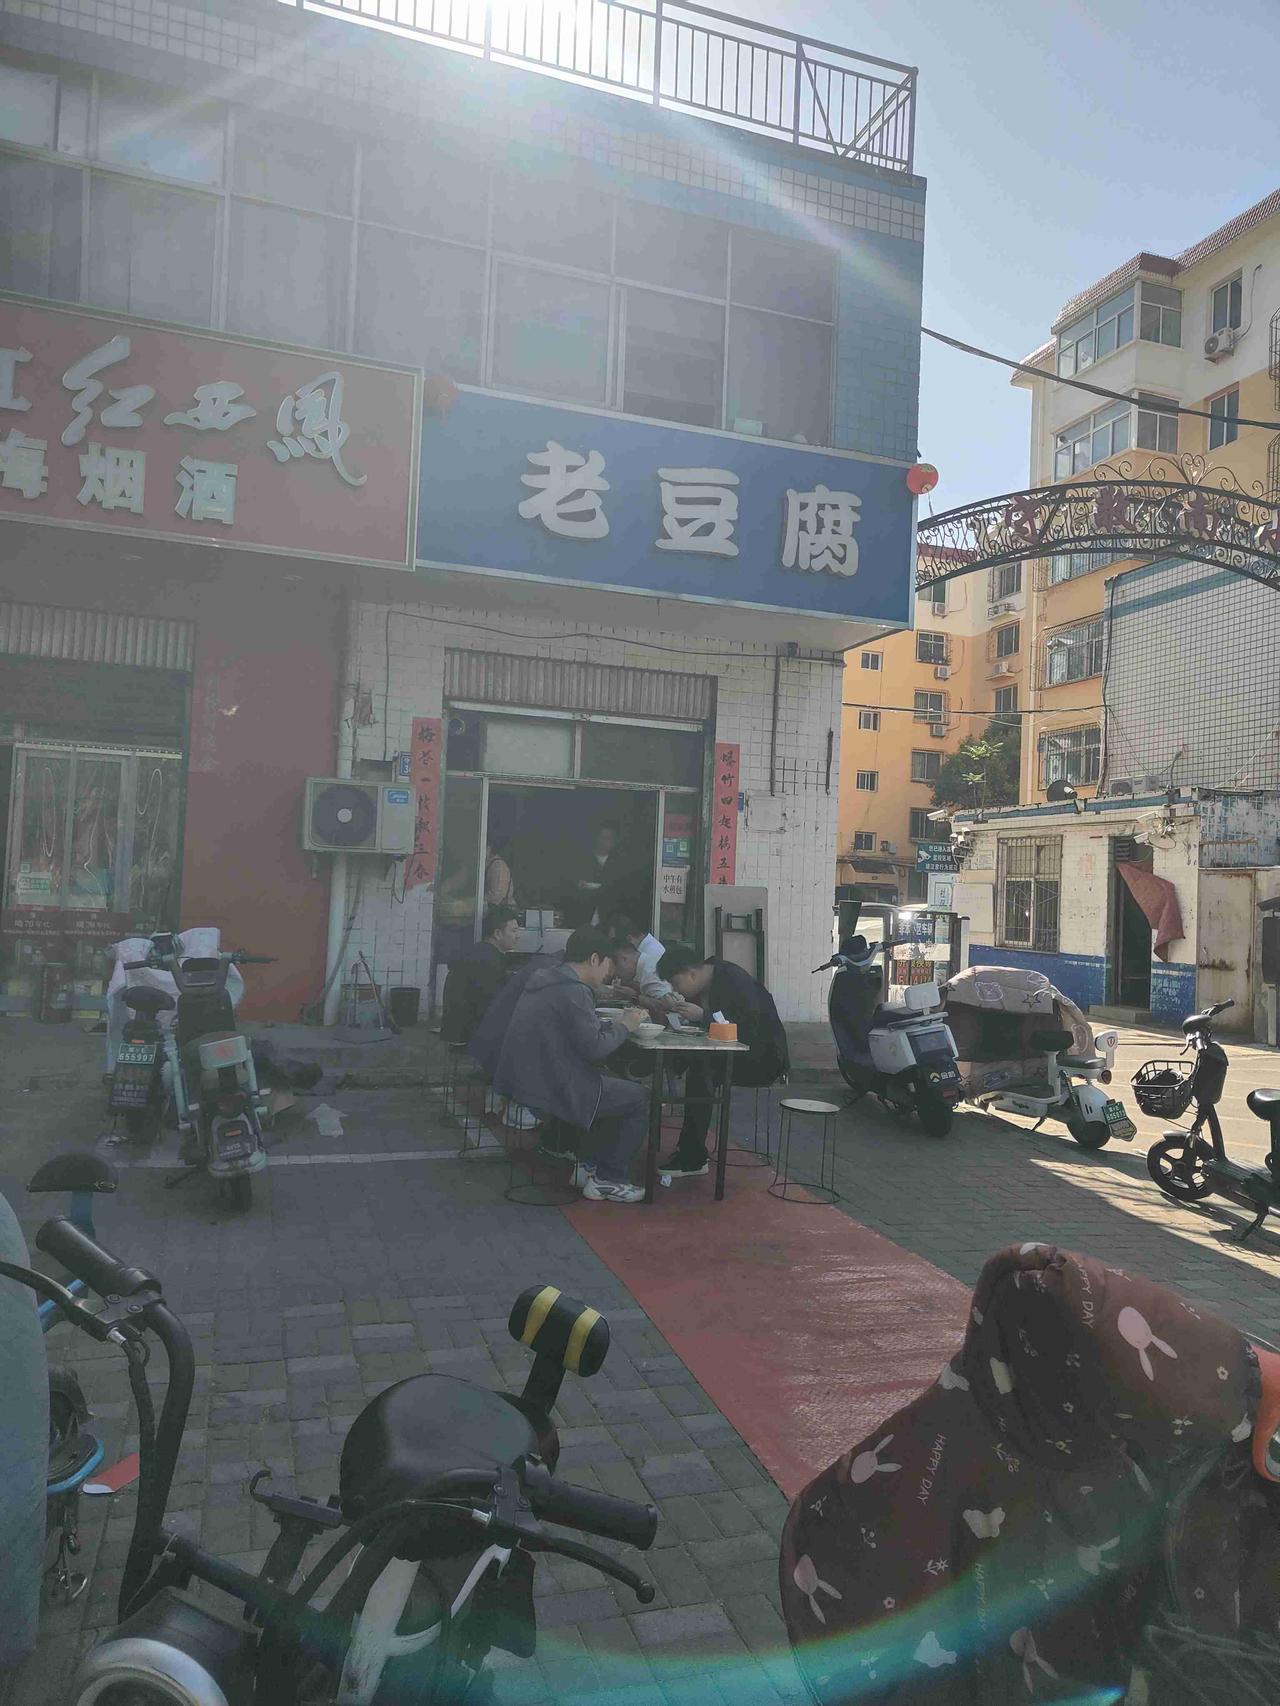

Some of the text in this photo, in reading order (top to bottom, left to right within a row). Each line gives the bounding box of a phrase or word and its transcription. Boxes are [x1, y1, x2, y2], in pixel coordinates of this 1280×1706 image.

[518, 440, 862, 576] 老豆腐
[1082, 1300, 1094, 1329] DAY
[916, 1433, 946, 1505] HAPPY DAY
